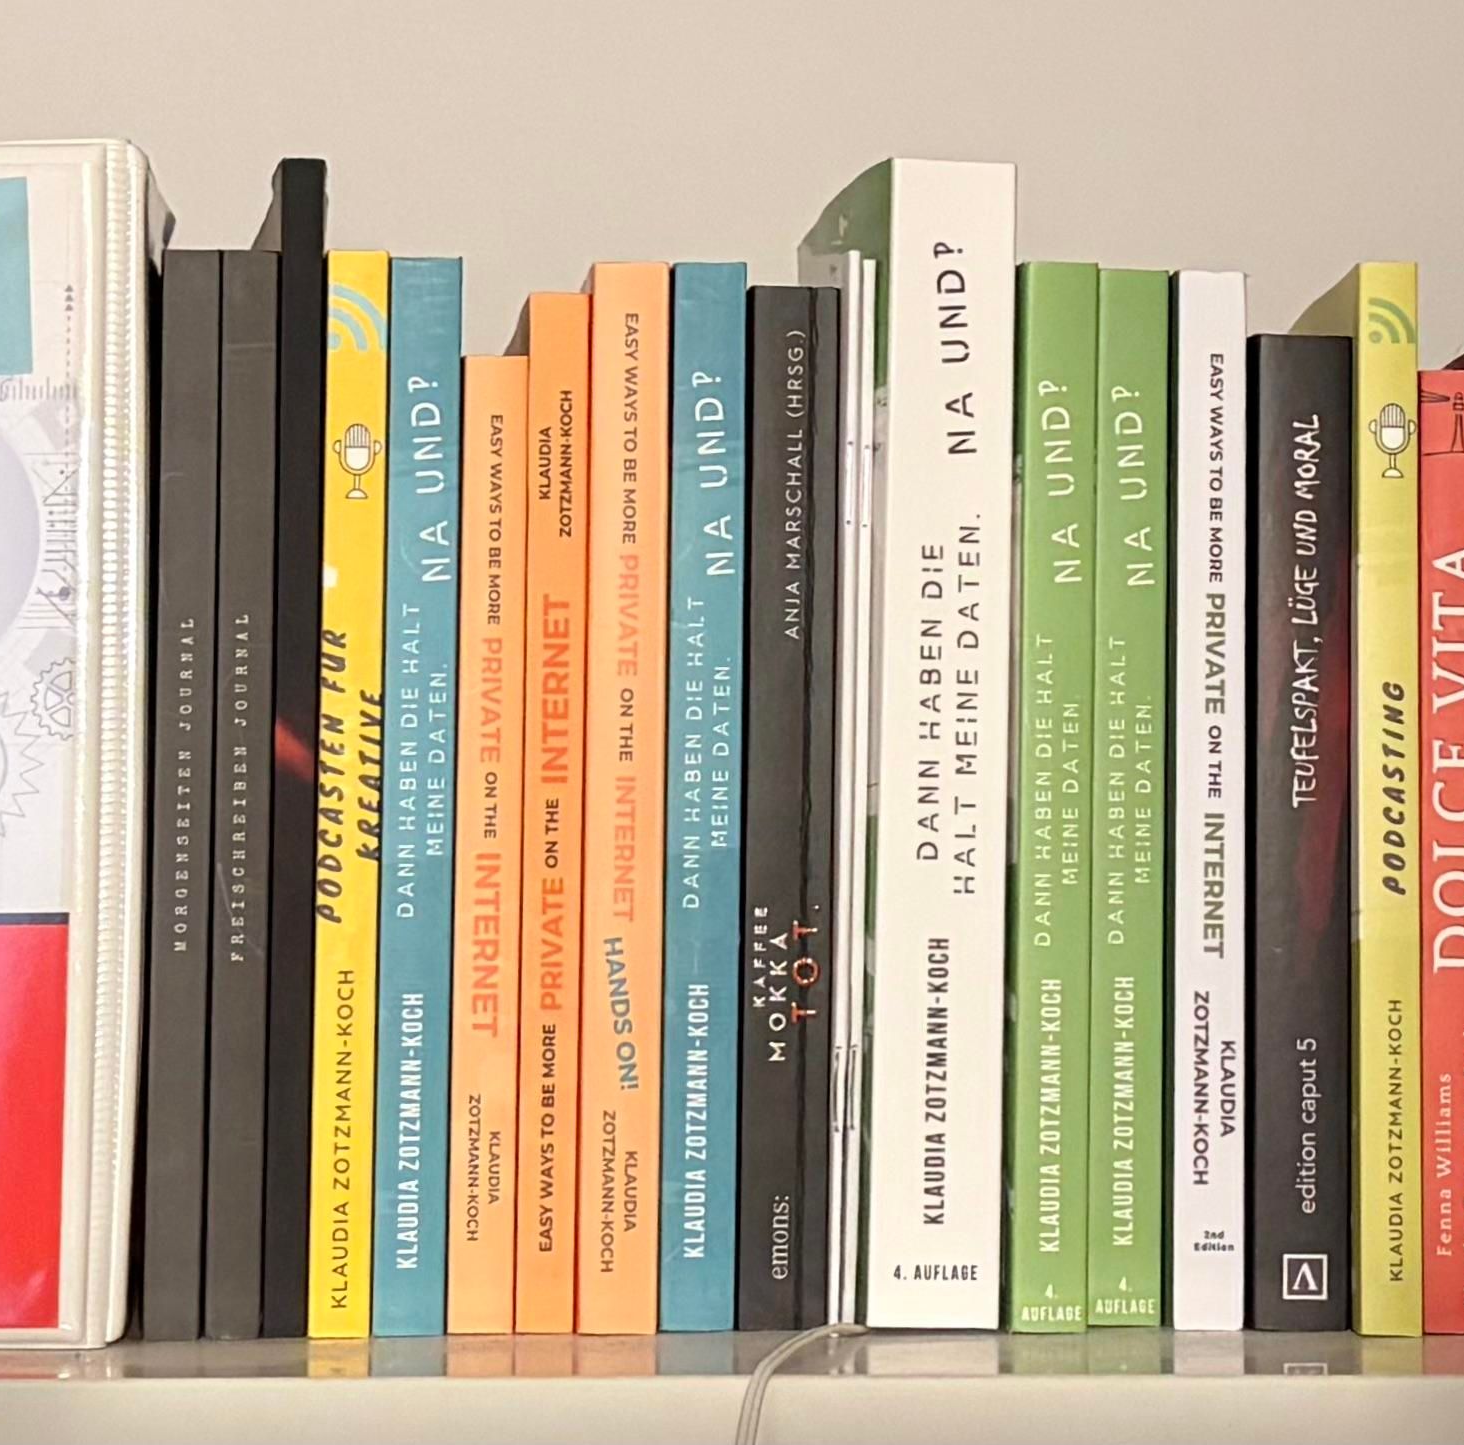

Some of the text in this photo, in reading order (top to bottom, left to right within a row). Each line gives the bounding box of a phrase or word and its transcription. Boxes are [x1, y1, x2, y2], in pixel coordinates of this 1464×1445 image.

[933, 242, 977, 454] NA UND?
[786, 331, 805, 643] ANJA MARSCHALL (HRSG.)
[917, 545, 943, 860] DANN HABEN DIE
[954, 515, 980, 894] HALT MEINE DATEN.
[1288, 415, 1322, 808] TEUFELSPAKT, LÜGE UND MORAL
[1382, 682, 1406, 895] PODCASTING
[539, 595, 571, 1252] EASY WAYS TO BE MORE PRIVATE ON THE INTERNET
[604, 938, 639, 1090] HANDS ON!
[753, 908, 768, 1007] KAFFEE
[768, 931, 789, 1061] MOKKA
[924, 939, 949, 1224] KLAUDIA ZOTZMANN-KOCH
[1295, 1039, 1321, 1213] edition caput 5
[1435, 1074, 1451, 1256] Fenna Williams
[772, 1196, 789, 1279] emons:
[894, 1265, 977, 1280] 4. AUFLAGE
